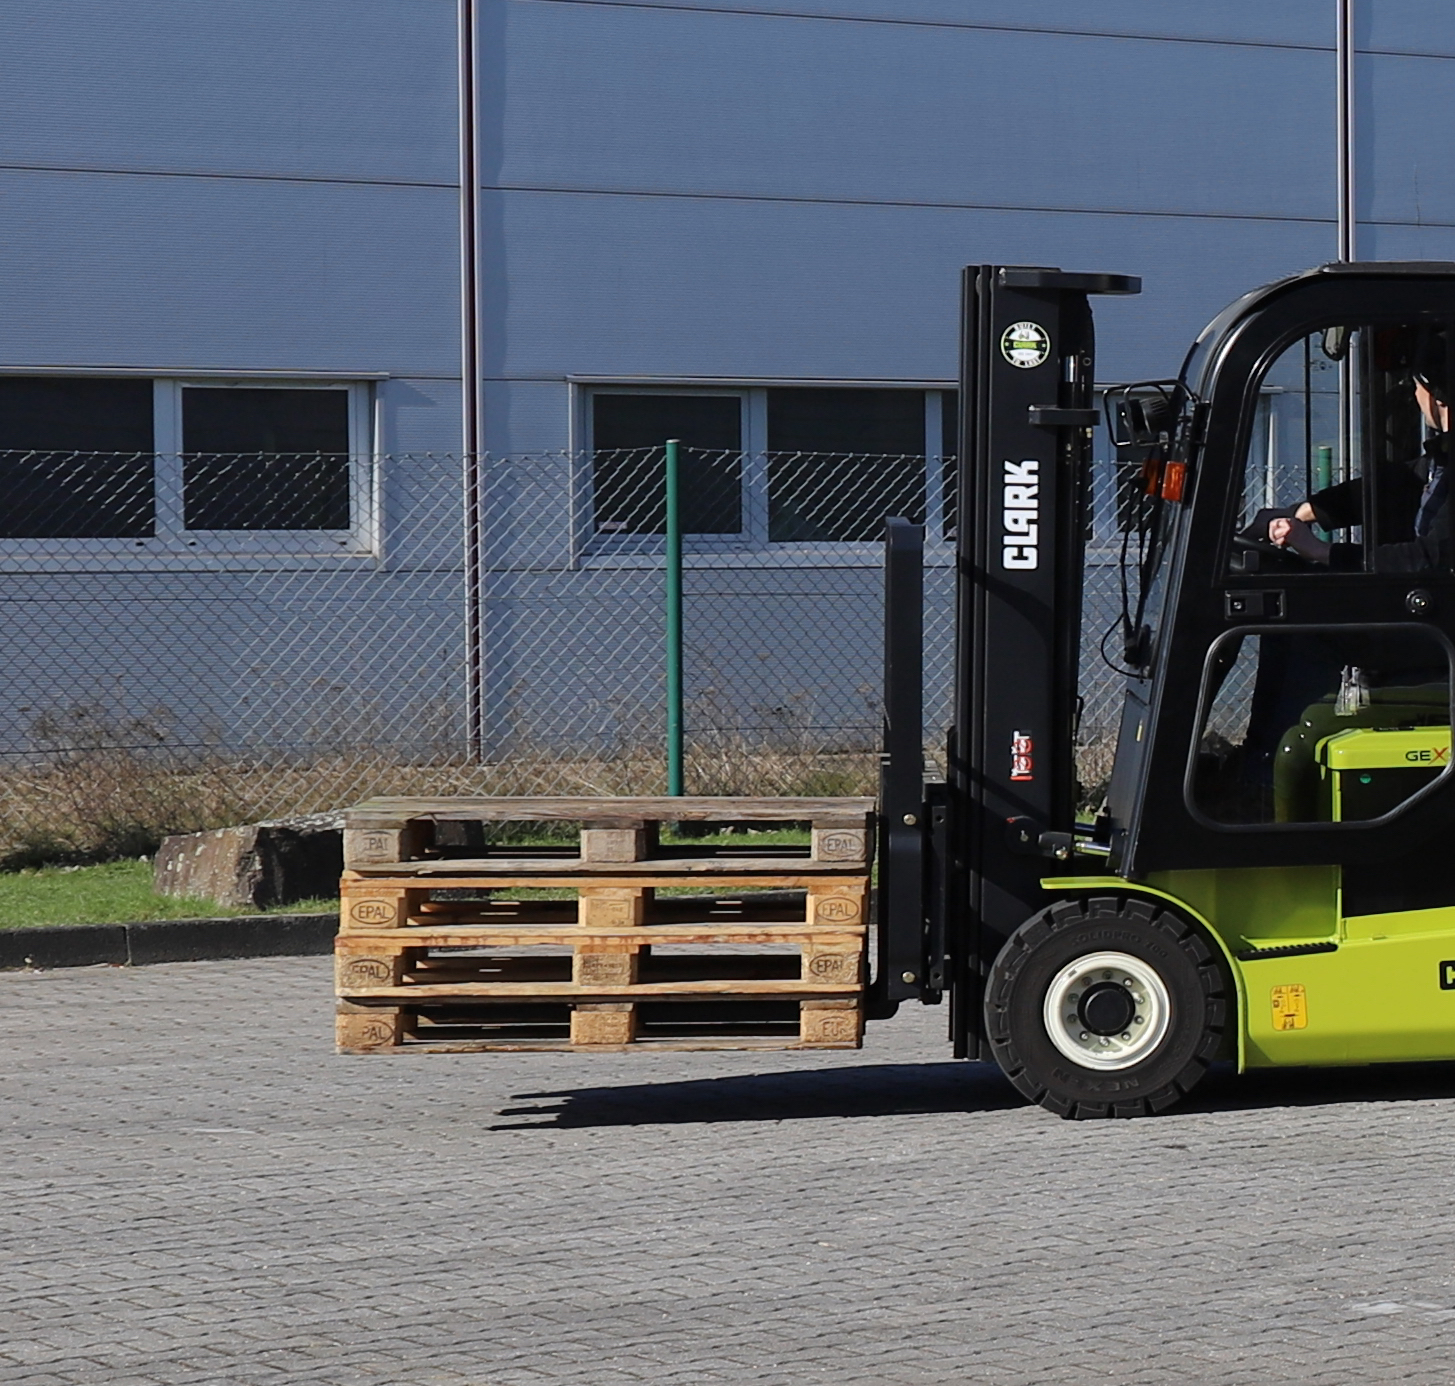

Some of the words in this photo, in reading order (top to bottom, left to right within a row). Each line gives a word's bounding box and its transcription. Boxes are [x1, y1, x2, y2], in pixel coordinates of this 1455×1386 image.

[1003, 460, 1039, 570] CLARK
[1405, 746, 1449, 765] GEX
[826, 838, 857, 852] EPAL
[358, 905, 391, 919] EPAL
[822, 902, 852, 917] EPAL
[361, 1026, 386, 1042] PAL
